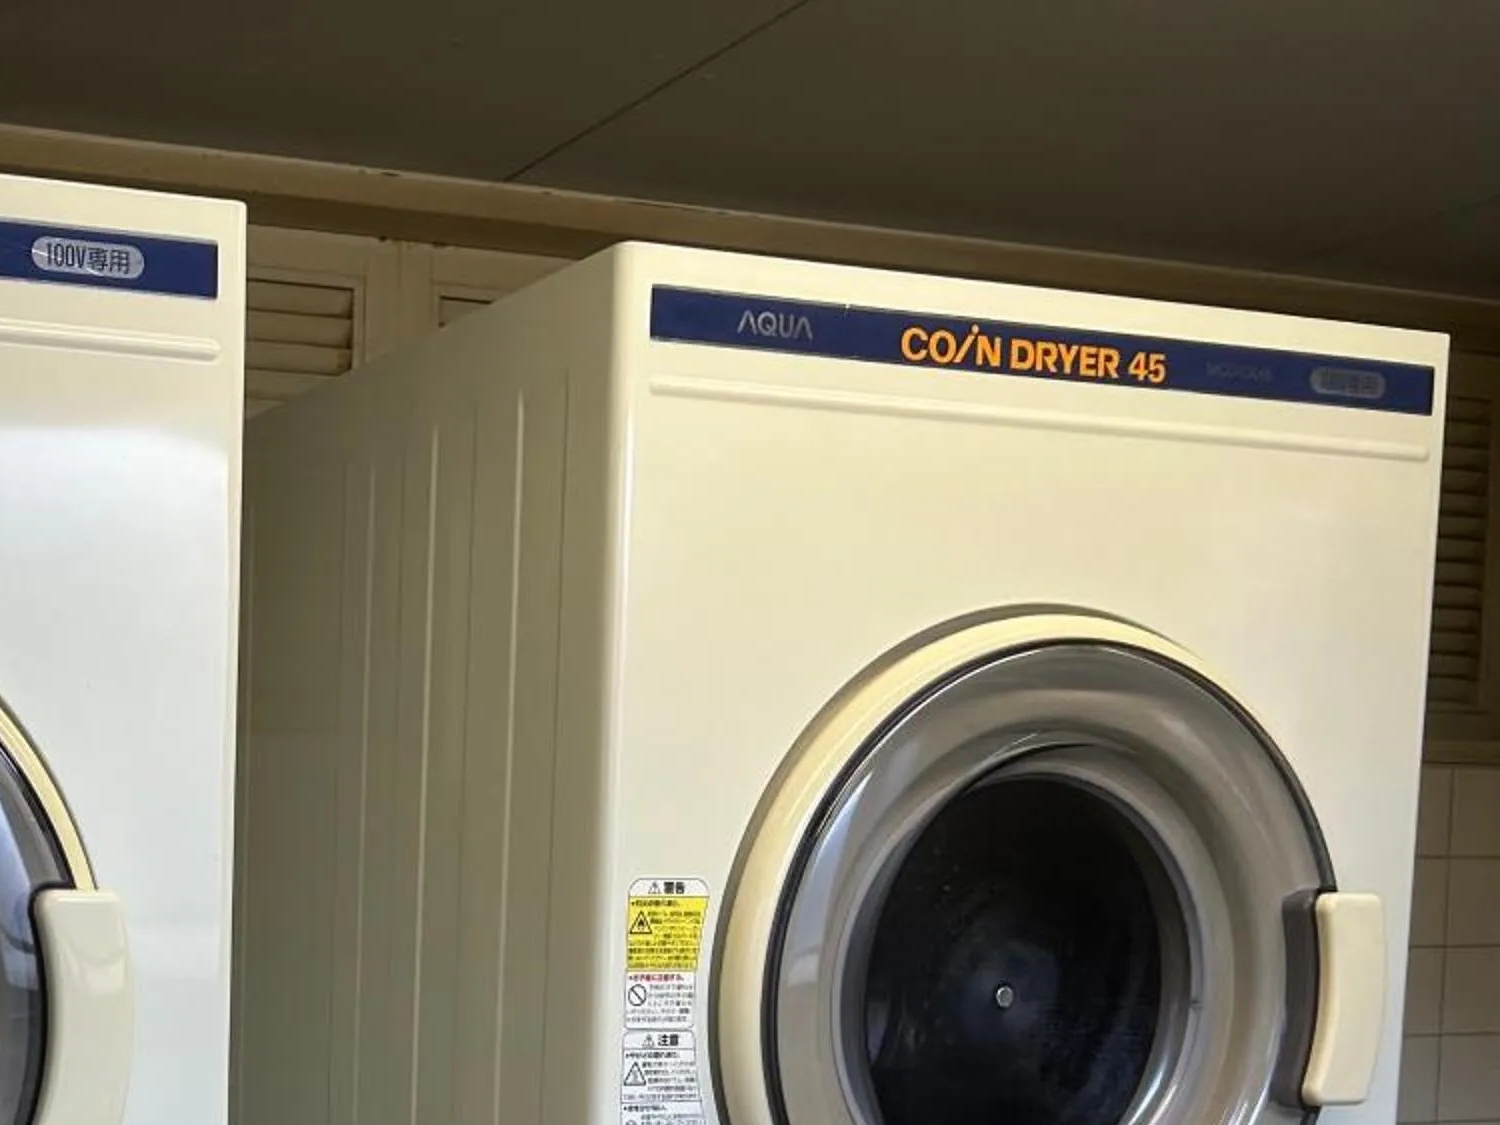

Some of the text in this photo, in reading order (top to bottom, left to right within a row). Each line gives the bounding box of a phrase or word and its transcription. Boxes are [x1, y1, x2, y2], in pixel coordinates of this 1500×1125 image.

[44, 240, 132, 276] 100V専用
[737, 309, 813, 341] AQUA
[1010, 337, 1119, 380] DRYER
[1128, 350, 1167, 385] 45
